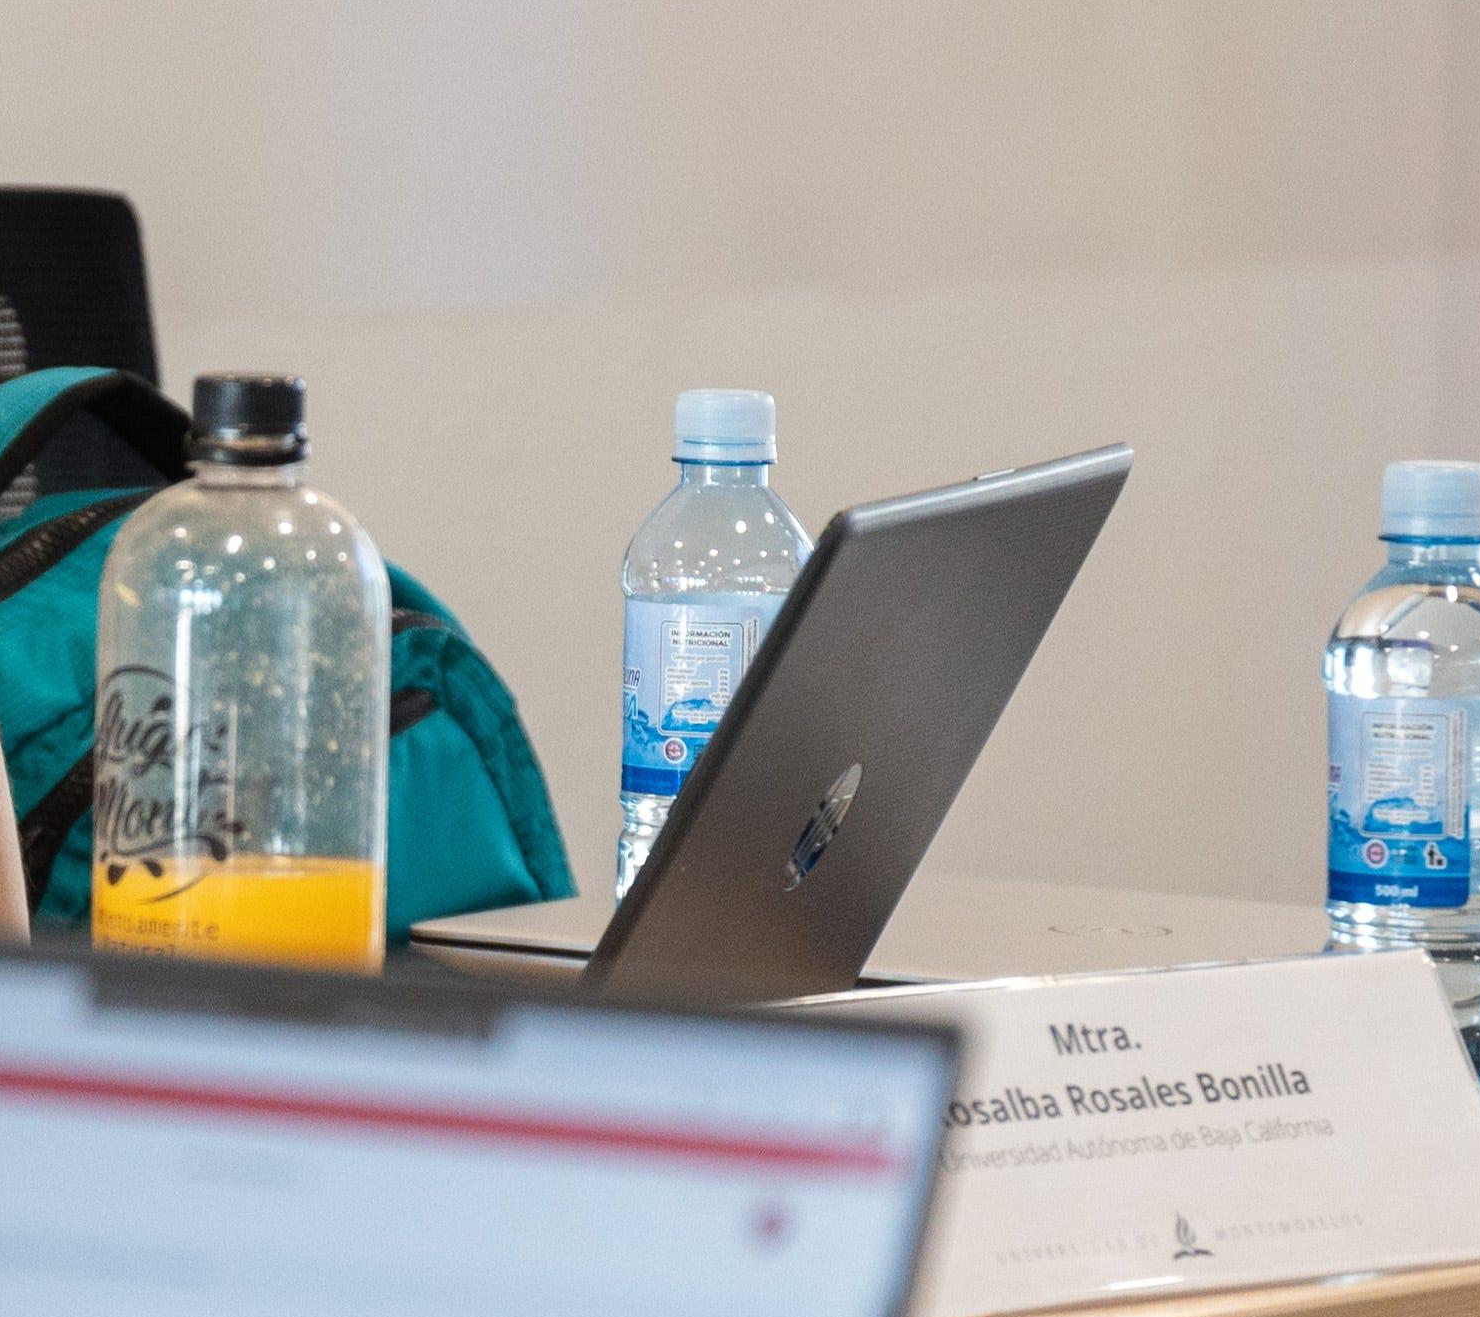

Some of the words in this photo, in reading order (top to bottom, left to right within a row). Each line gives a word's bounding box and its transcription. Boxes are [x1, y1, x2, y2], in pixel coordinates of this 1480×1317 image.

[1048, 1023, 1142, 1056] Mtra.
[1065, 1076, 1194, 1118] Rosales
[1196, 1062, 1313, 1105] Bonilla
[1067, 1130, 1168, 1162] Autónoma
[1172, 1127, 1199, 1151] de
[1199, 1124, 1242, 1152] Baja
[1243, 1114, 1336, 1146] California
